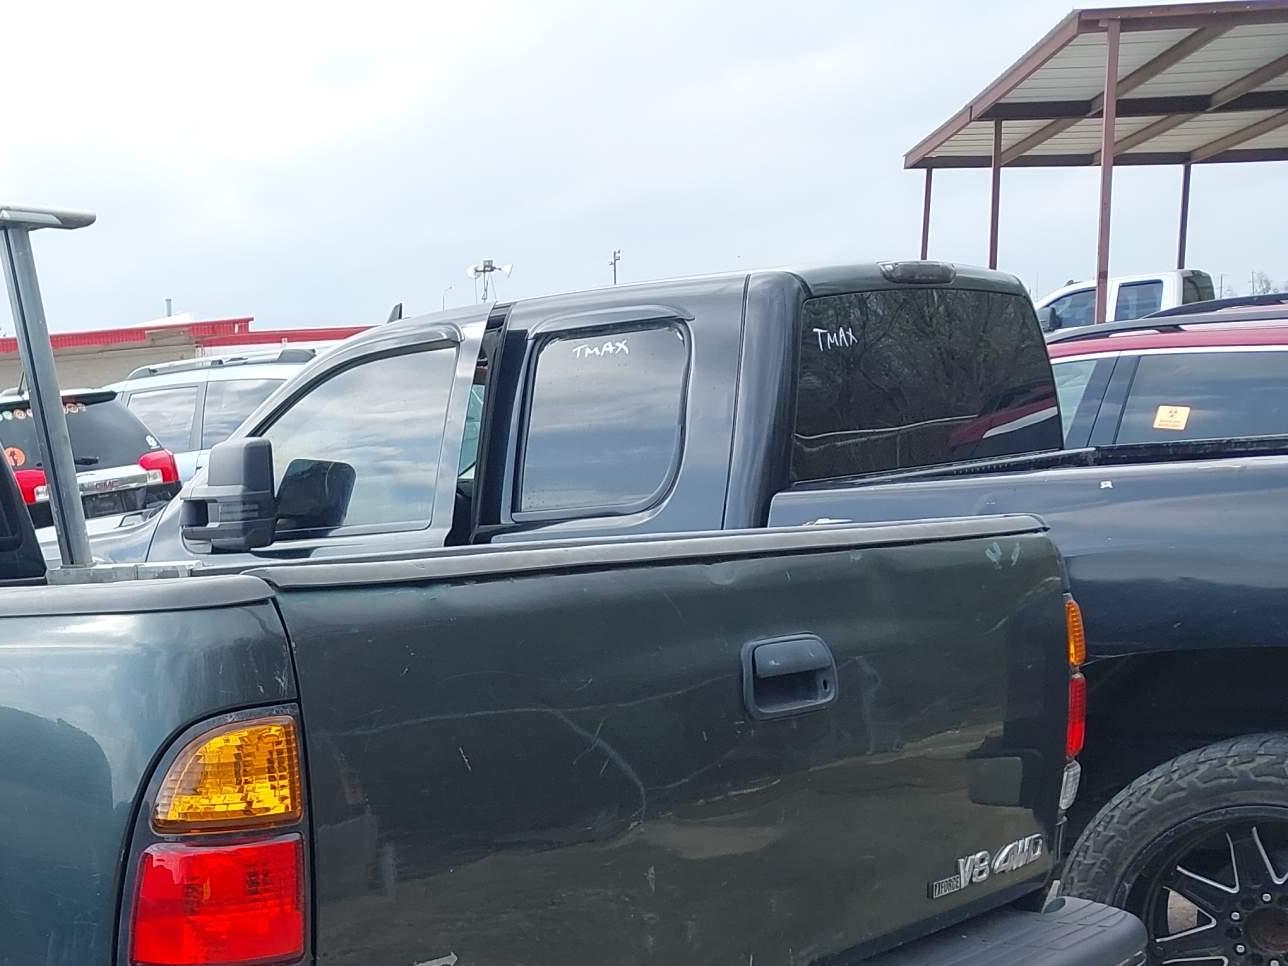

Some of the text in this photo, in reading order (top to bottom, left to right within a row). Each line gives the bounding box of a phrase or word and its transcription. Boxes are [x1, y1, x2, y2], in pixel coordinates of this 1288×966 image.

[572, 340, 629, 358] TMAX
[813, 327, 858, 351] TMAX
[958, 850, 991, 889] V8
[993, 833, 1043, 874] 4WD
